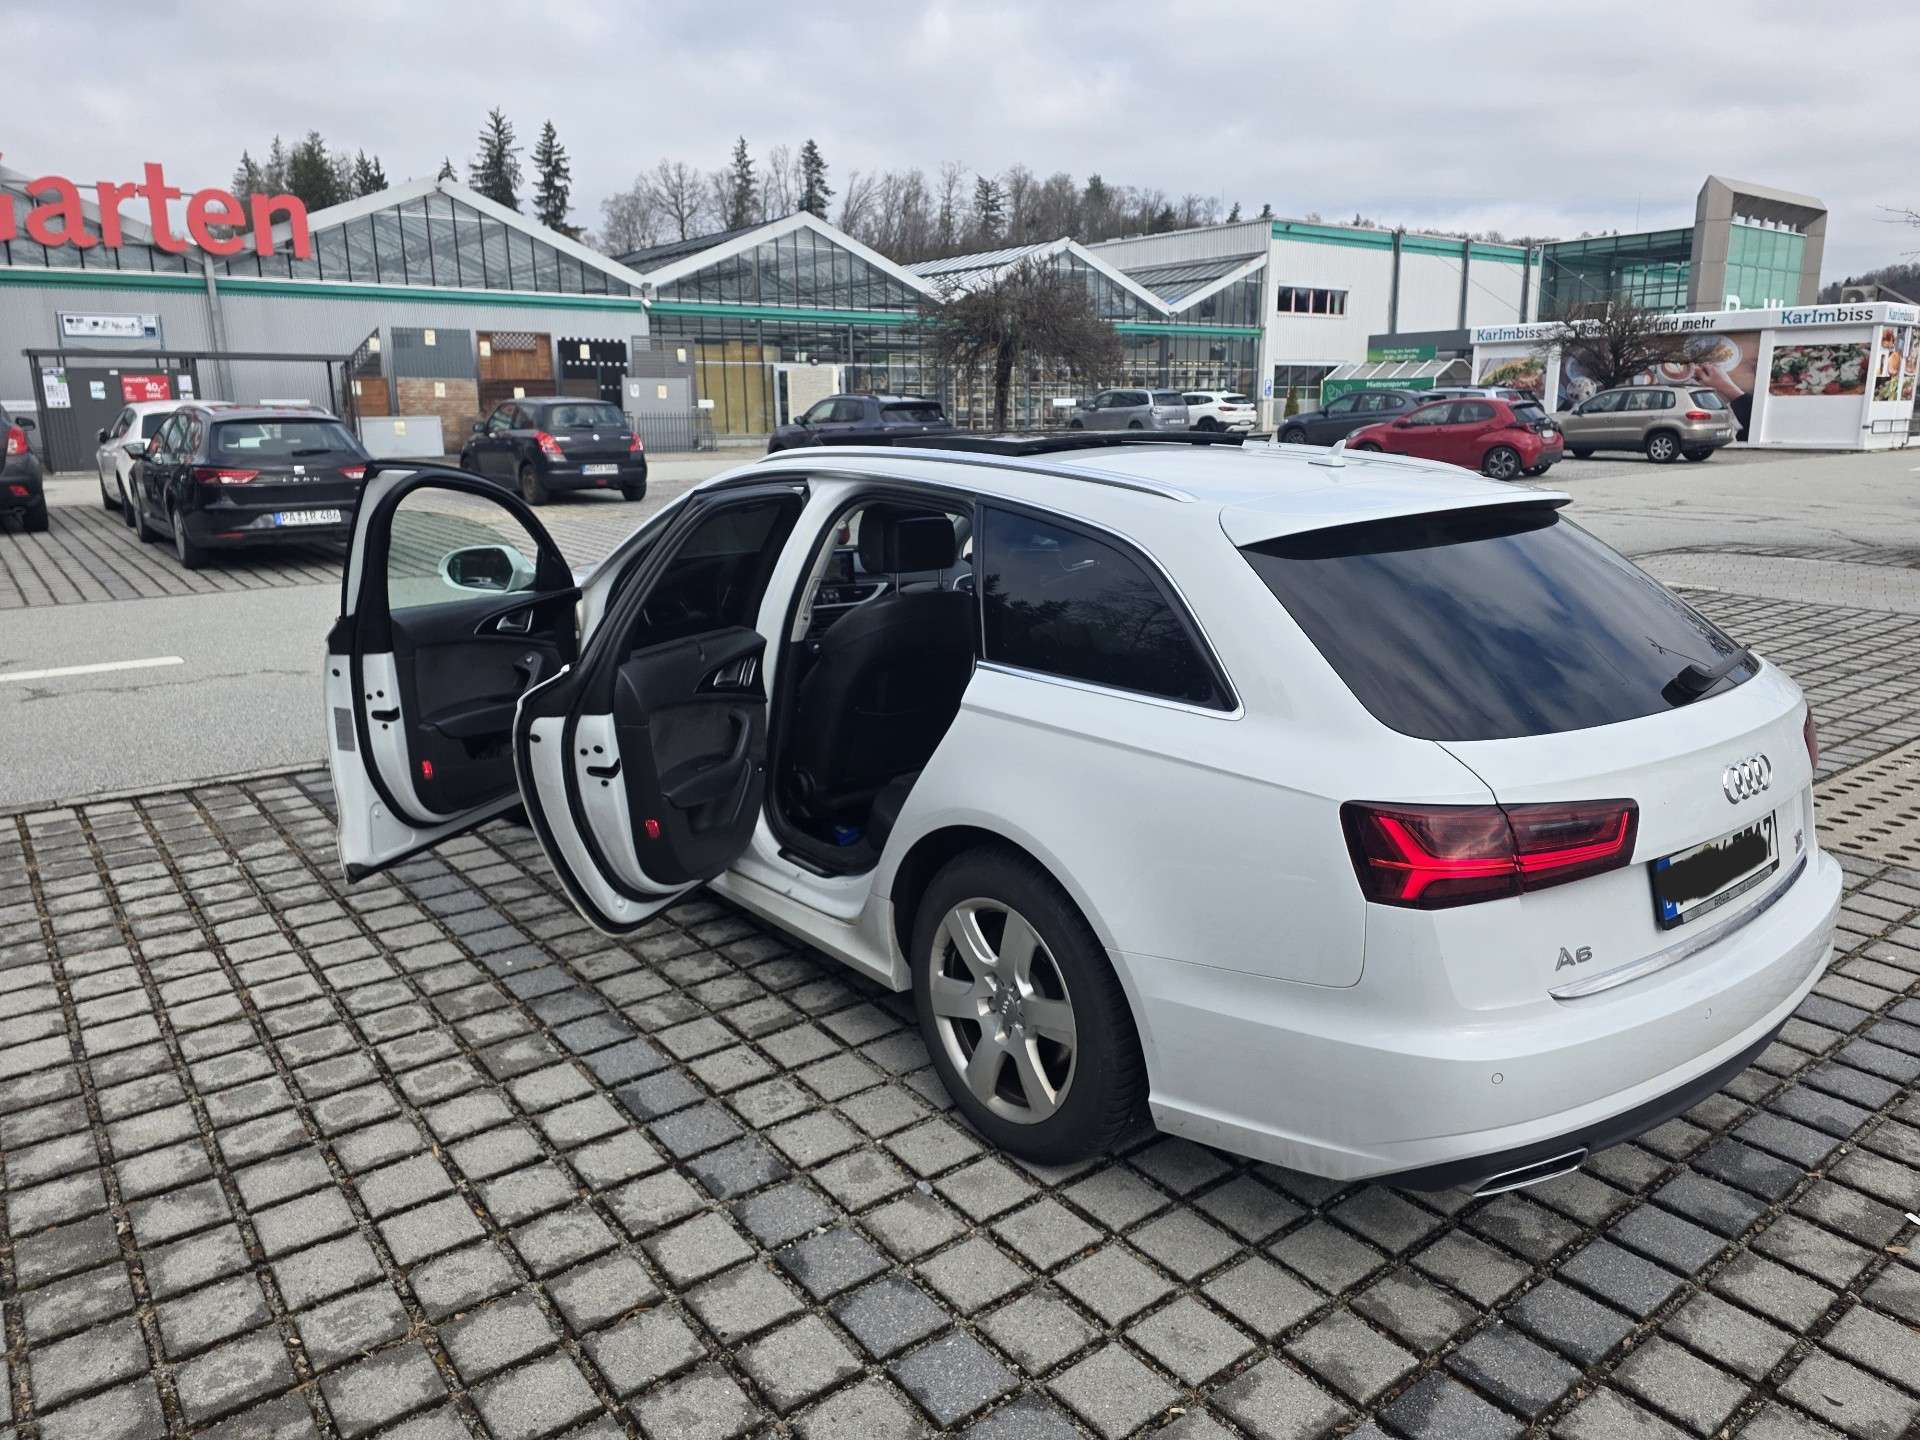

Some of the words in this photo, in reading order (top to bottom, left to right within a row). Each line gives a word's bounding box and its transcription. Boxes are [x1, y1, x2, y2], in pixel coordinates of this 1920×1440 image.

[0, 155, 312, 260] arten
[1682, 316, 1716, 330] mehr
[1781, 308, 1873, 325] KarImbiss
[1476, 327, 1542, 342] KarImbiss
[1554, 946, 1593, 971] A6
